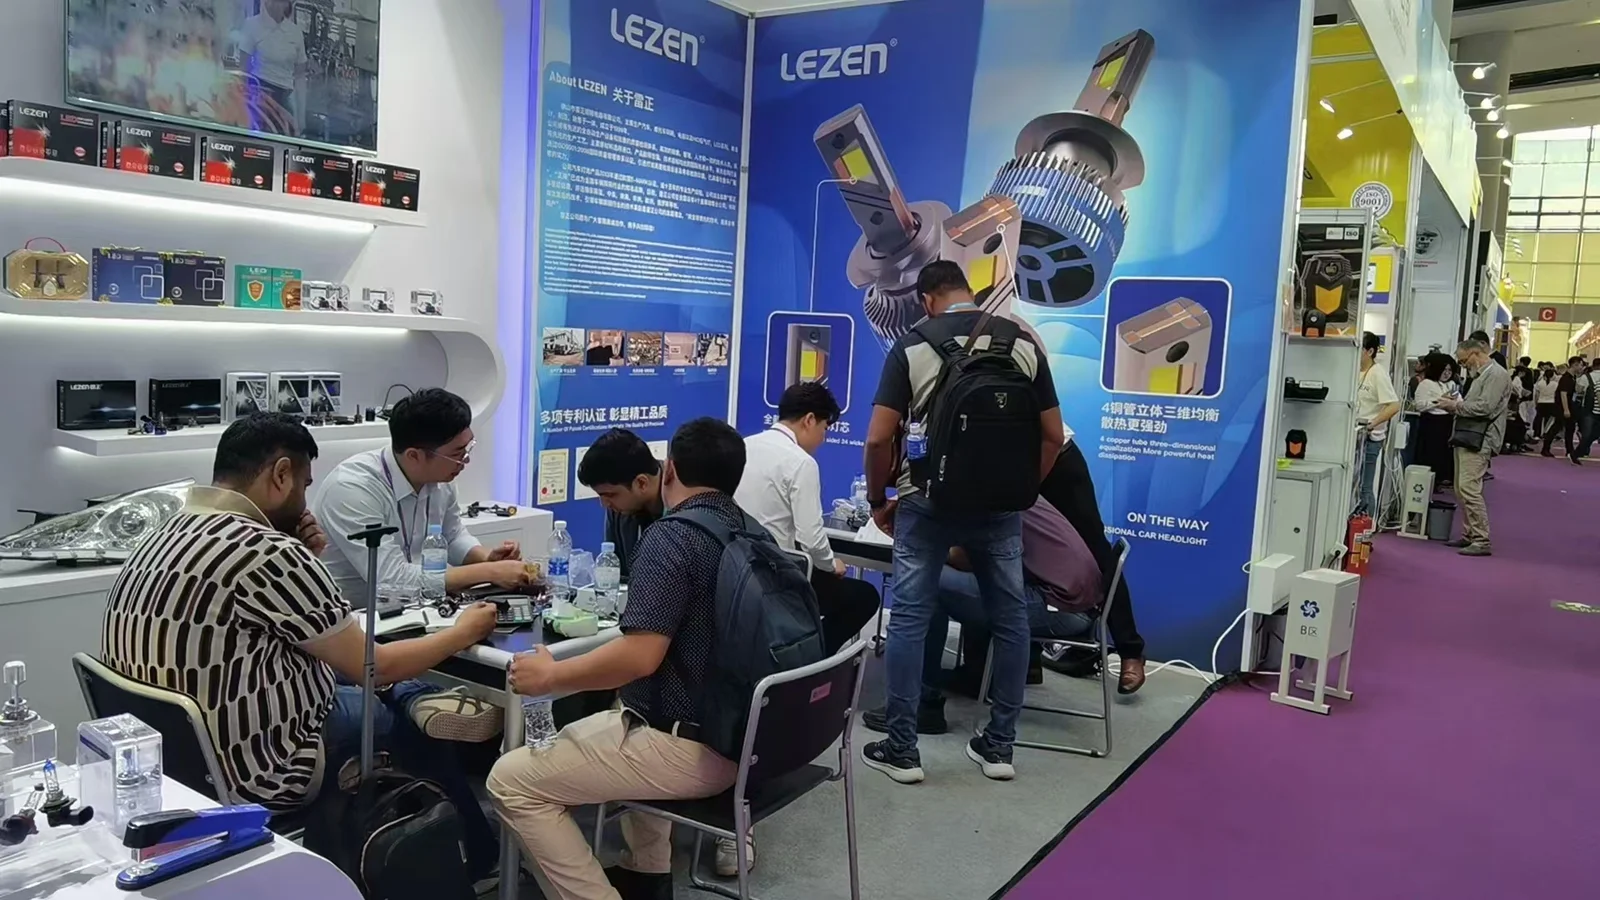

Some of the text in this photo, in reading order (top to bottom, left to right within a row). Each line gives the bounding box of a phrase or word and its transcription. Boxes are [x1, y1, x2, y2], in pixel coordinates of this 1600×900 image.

[610, 8, 698, 66] LEZEN
[780, 43, 888, 81] LEZEN
[549, 71, 607, 96] About LEZEN
[612, 87, 654, 112] 关于雷正
[19, 106, 48, 118] LEZEN
[126, 127, 152, 137] LEZEN
[210, 142, 234, 152] LEZEN
[292, 155, 314, 164] LEZEN
[365, 165, 386, 175] LEZEN
[1360, 198, 1381, 206] 9001
[1542, 309, 1553, 320] C
[540, 405, 668, 425] 多项专利认证 彰显精工品质
[1101, 401, 1220, 423] 4铜管立体三维均衡
[1101, 416, 1167, 434] 散热更强劲
[1099, 444, 1215, 460] equalization More powerful heat
[1106, 437, 1130, 445] copper
[1132, 438, 1148, 446] tube
[1149, 440, 1216, 451] three-dimensional
[1098, 452, 1136, 461] dissipation
[1127, 511, 1209, 531] ON THE WAY
[1138, 530, 1156, 539] CAR
[1158, 532, 1208, 546] HEADLIGHT
